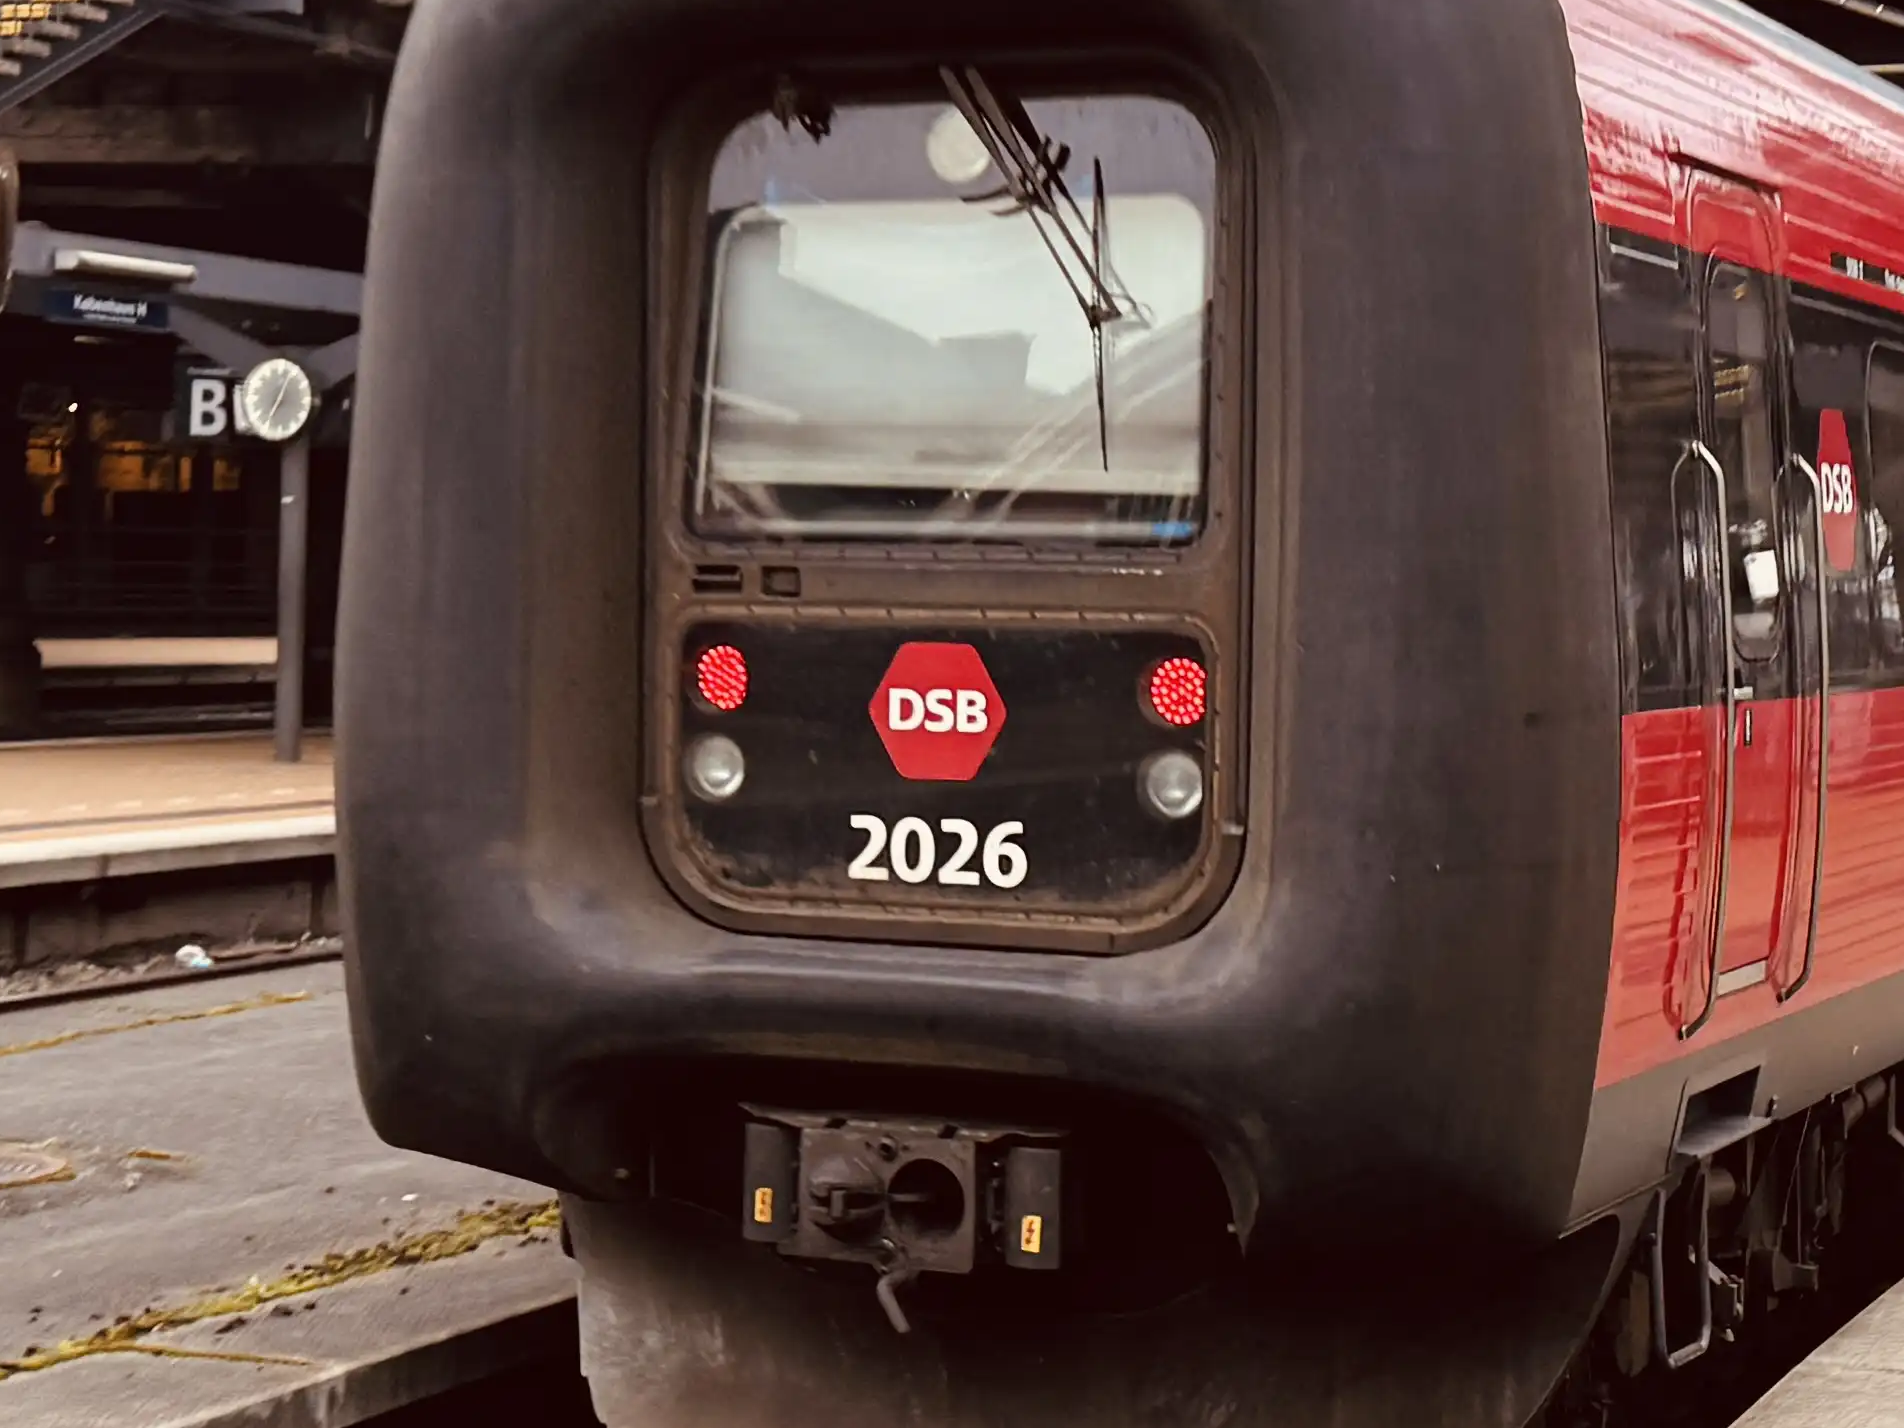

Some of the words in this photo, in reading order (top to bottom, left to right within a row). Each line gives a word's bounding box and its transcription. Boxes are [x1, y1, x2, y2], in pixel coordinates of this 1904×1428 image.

[189, 378, 228, 437] B
[1820, 462, 1853, 514] DSB
[888, 687, 988, 733] DSB
[848, 814, 1028, 889] 2026
